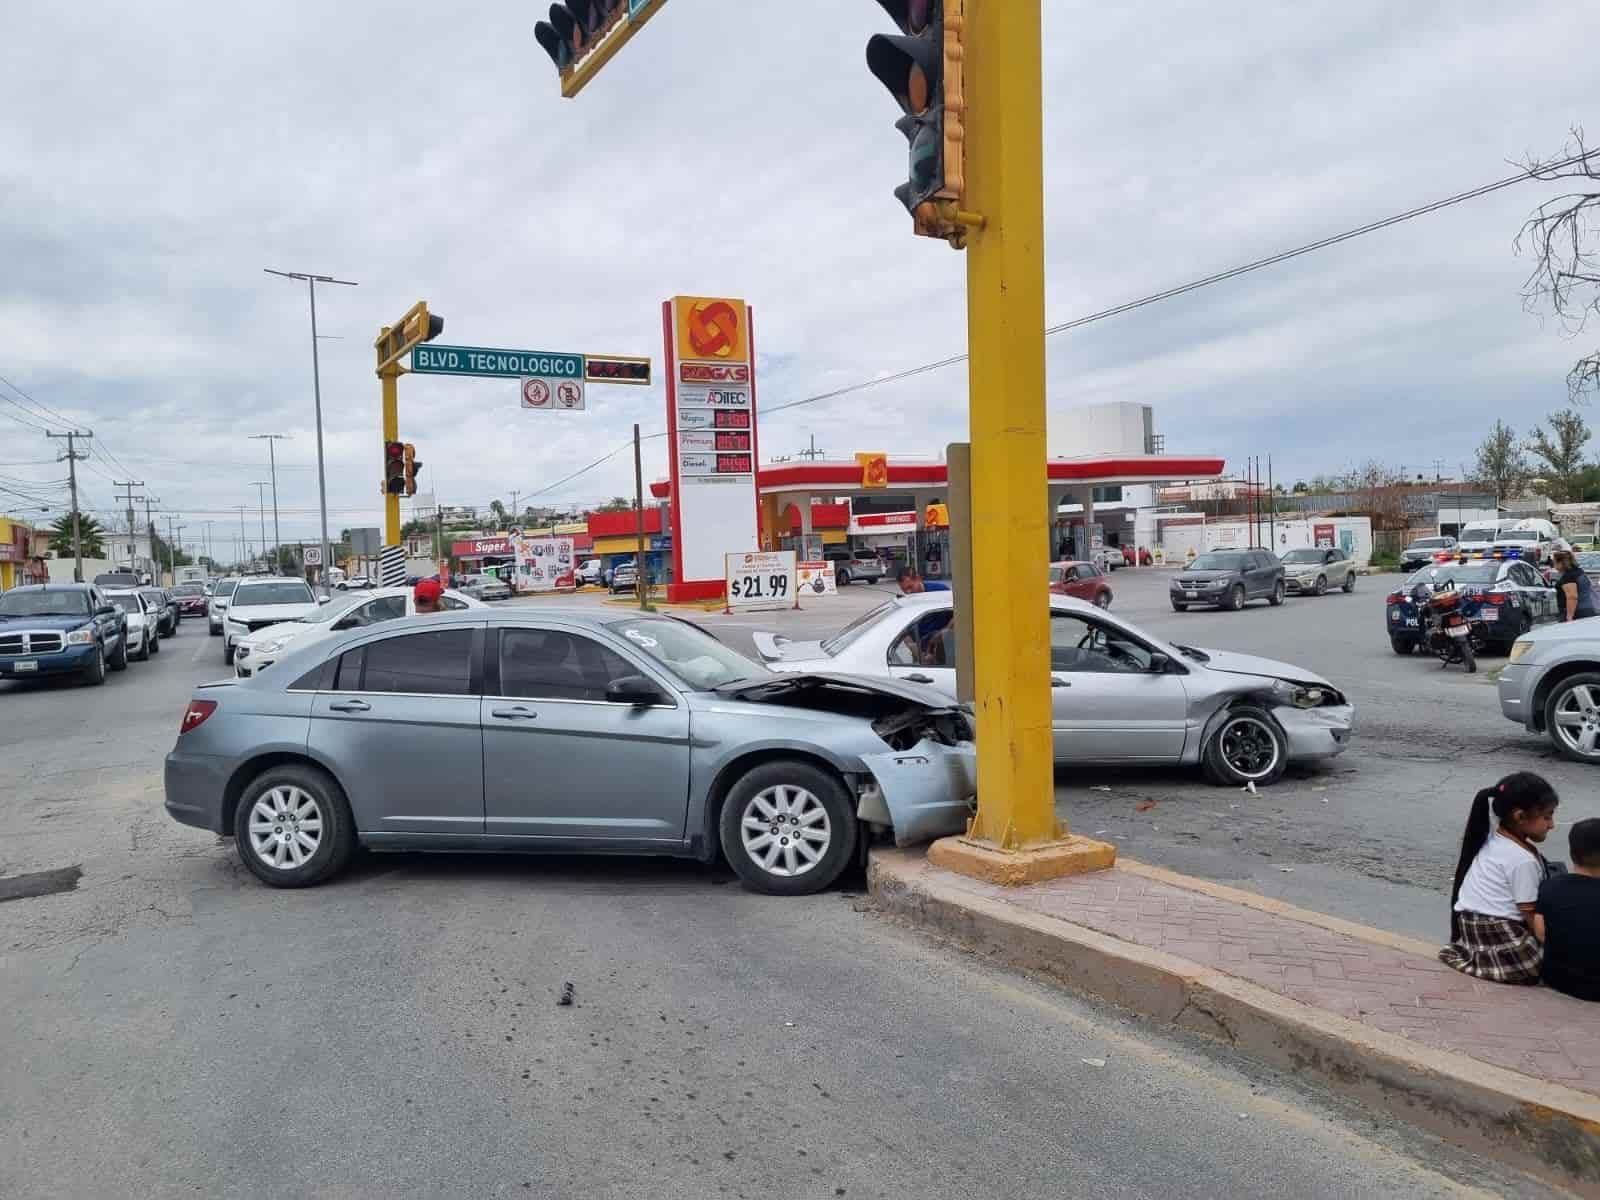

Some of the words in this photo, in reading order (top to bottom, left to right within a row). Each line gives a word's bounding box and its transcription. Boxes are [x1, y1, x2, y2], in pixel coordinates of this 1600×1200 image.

[419, 351, 464, 369] BLVD.
[468, 353, 576, 375] TECNOLOGICO
[475, 541, 506, 553] Super
